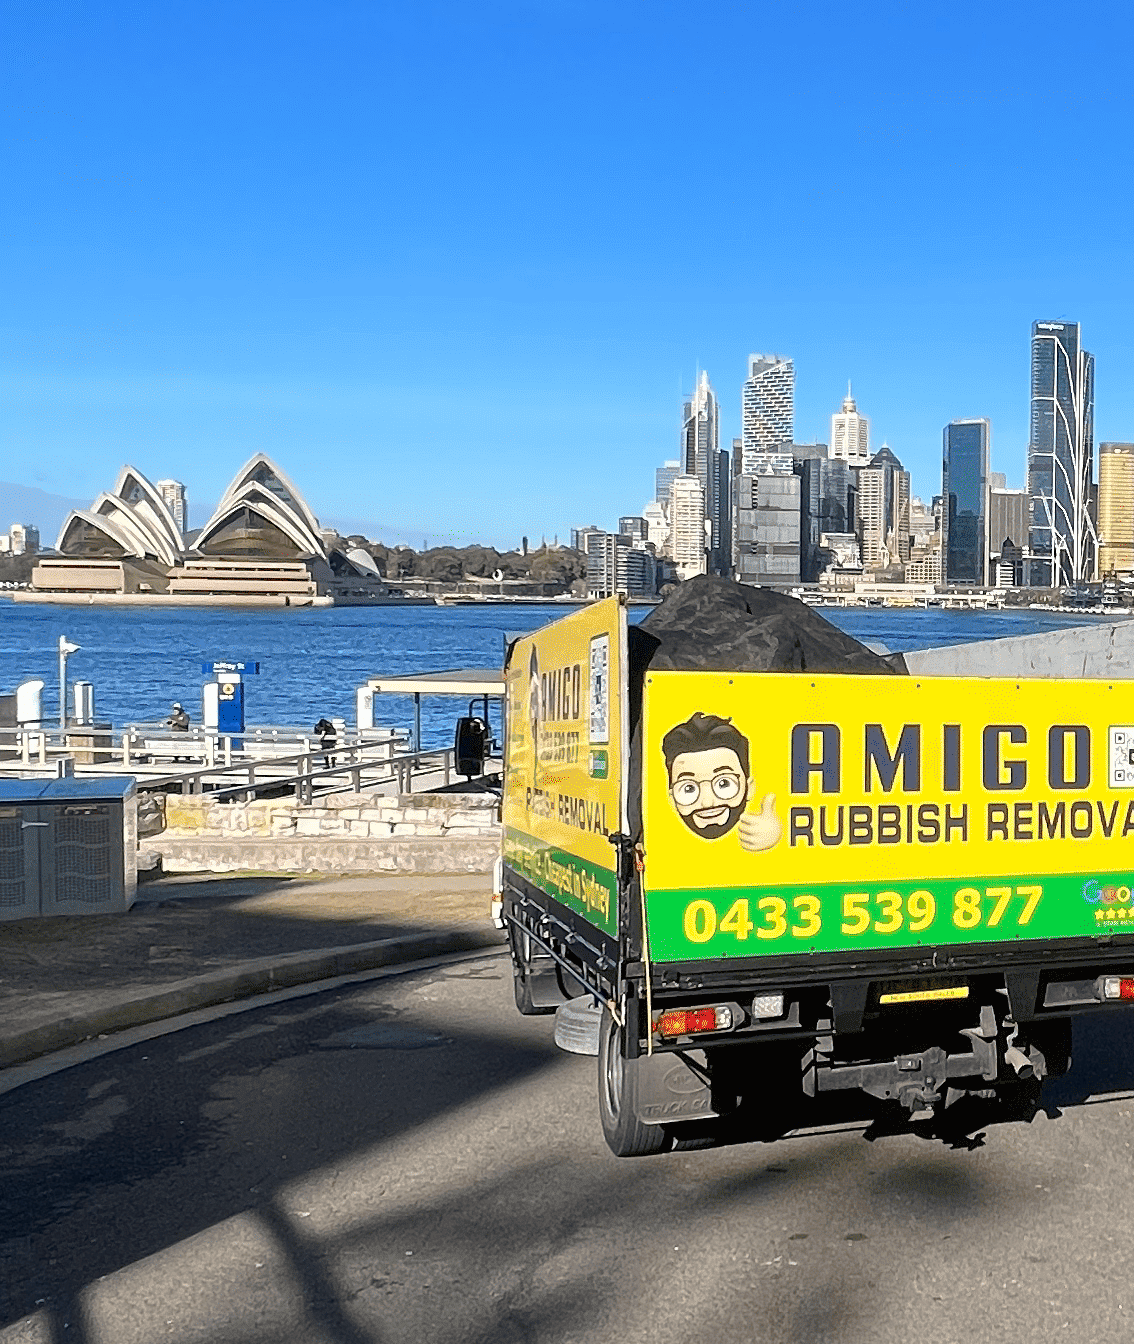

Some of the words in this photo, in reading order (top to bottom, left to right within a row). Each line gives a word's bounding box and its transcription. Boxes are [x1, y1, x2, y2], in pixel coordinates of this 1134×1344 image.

[541, 663, 581, 723] AMIGO
[789, 723, 1092, 794] AMIGO
[558, 793, 609, 837] REMOVAL
[789, 803, 968, 847] RUBBISH
[683, 896, 822, 944] 0433
[840, 889, 937, 936] 539
[952, 884, 1044, 929] 877
